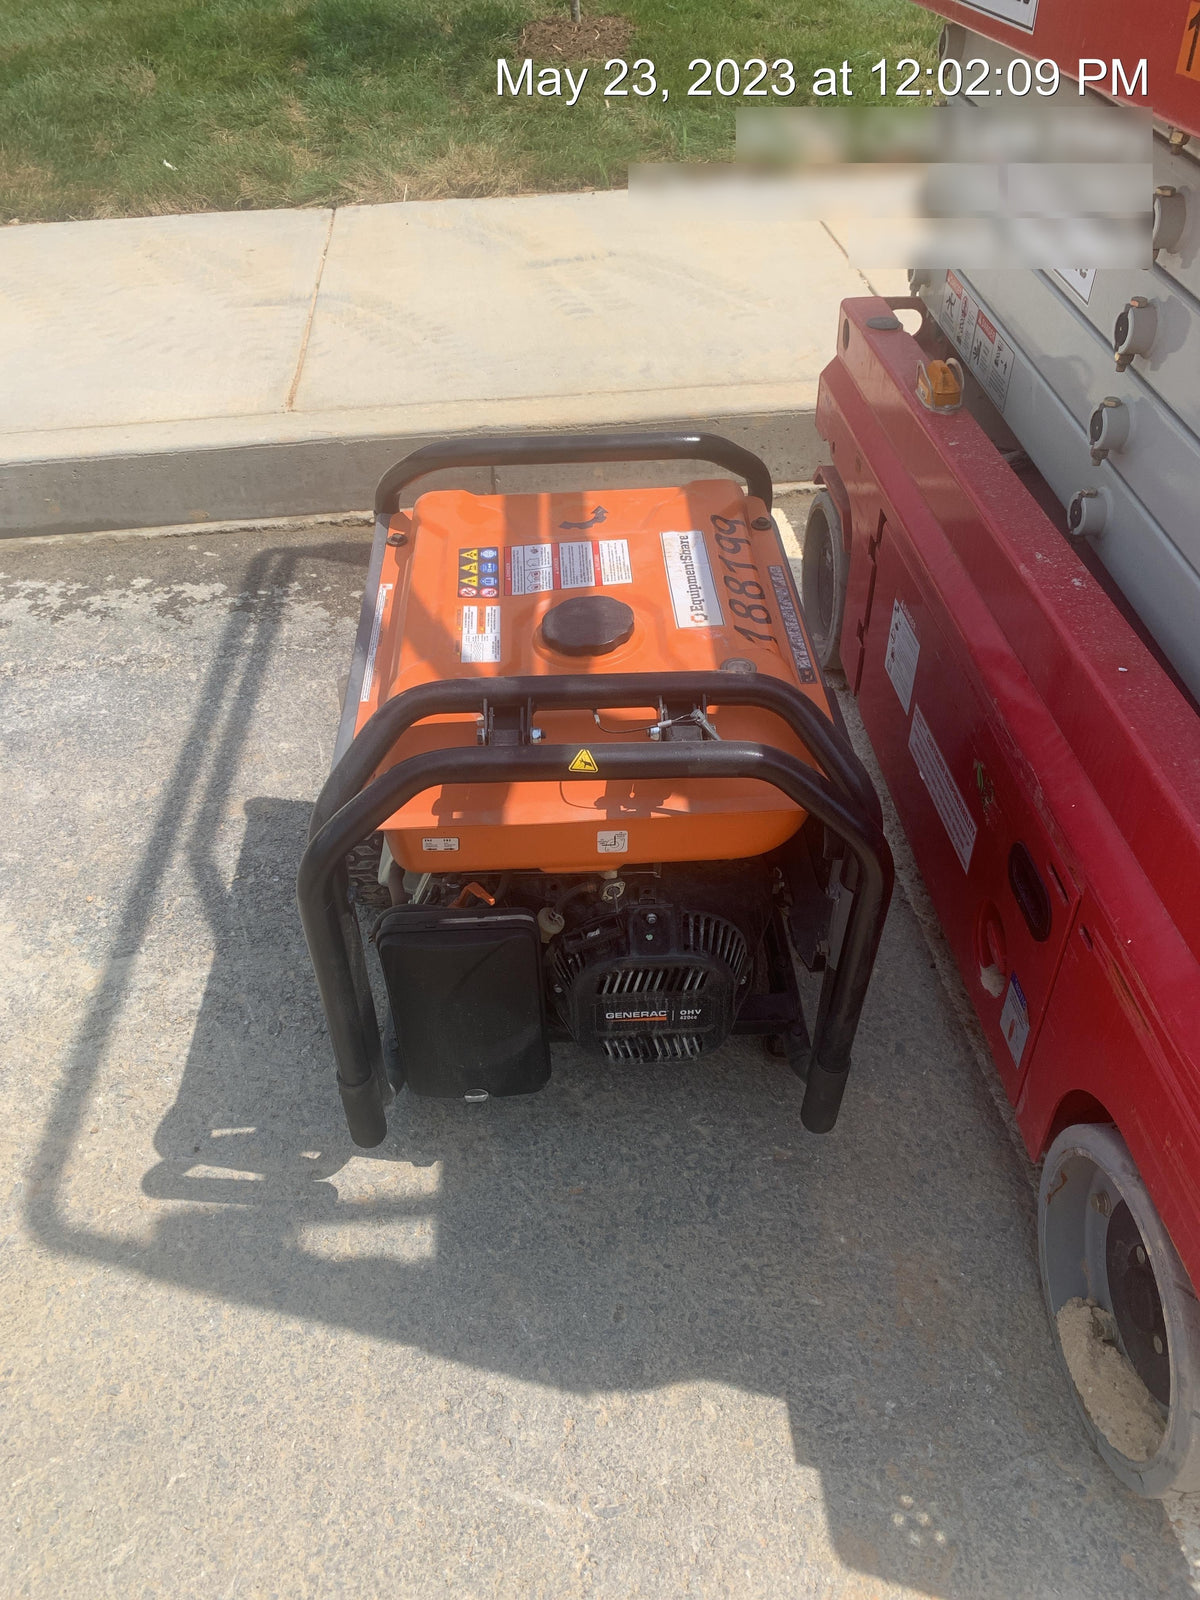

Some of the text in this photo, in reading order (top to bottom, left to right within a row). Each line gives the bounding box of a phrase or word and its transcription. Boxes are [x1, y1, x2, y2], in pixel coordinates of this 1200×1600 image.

[680, 535, 706, 612] EquipmentShare
[710, 514, 779, 646] 188199
[605, 1010, 667, 1019] GENERAC
